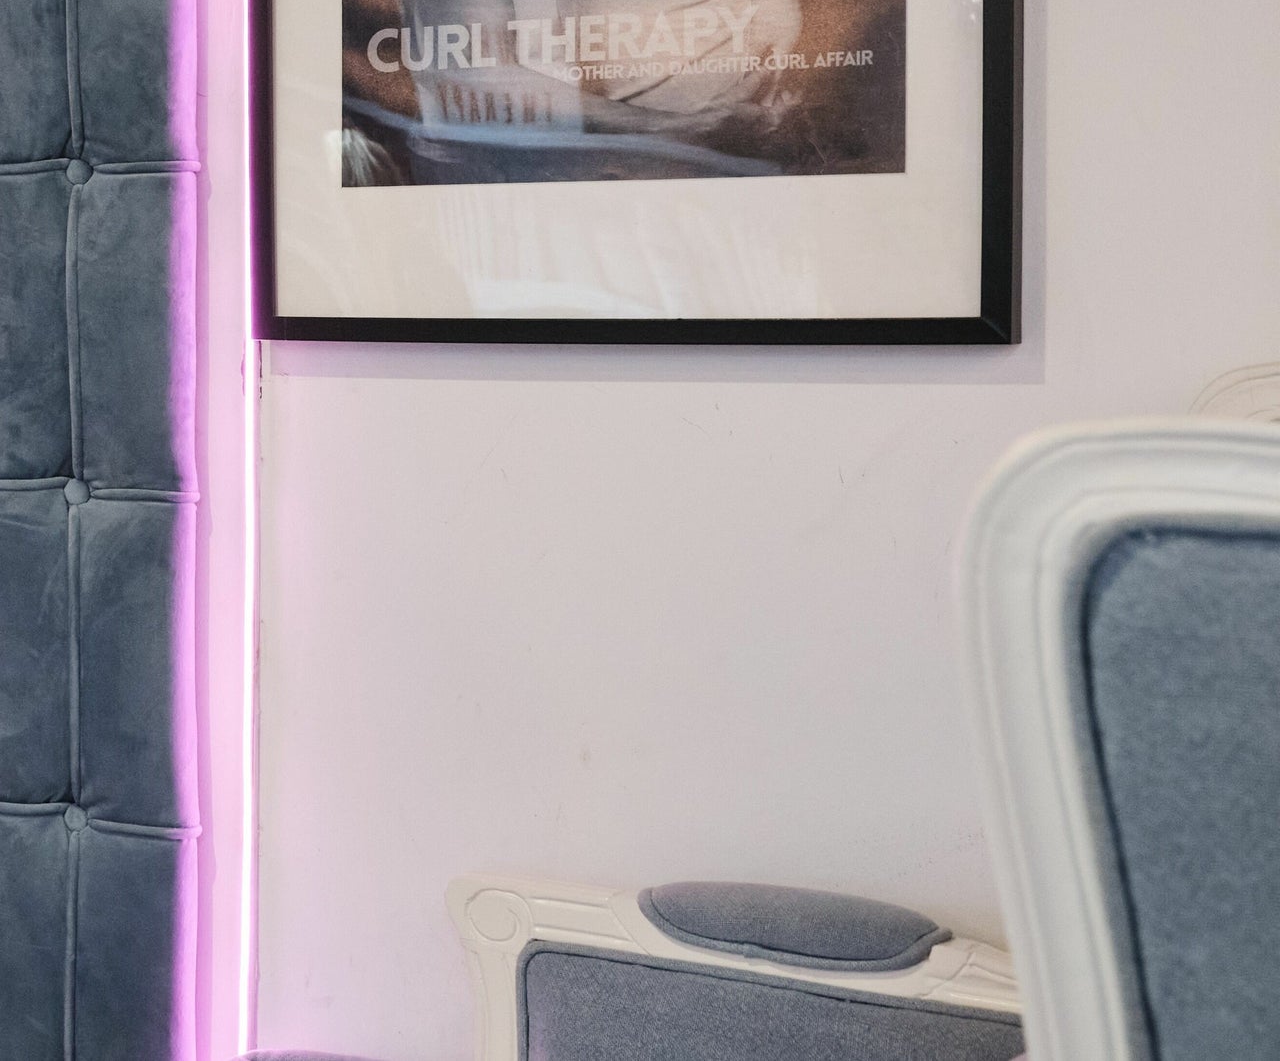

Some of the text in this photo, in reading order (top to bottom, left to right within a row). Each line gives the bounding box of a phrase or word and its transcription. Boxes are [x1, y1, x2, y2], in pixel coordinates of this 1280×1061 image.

[366, 4, 760, 73] CURL THERAPY
[554, 50, 874, 83] MOTHER AND DAUGHTER CURL AFFAIR
